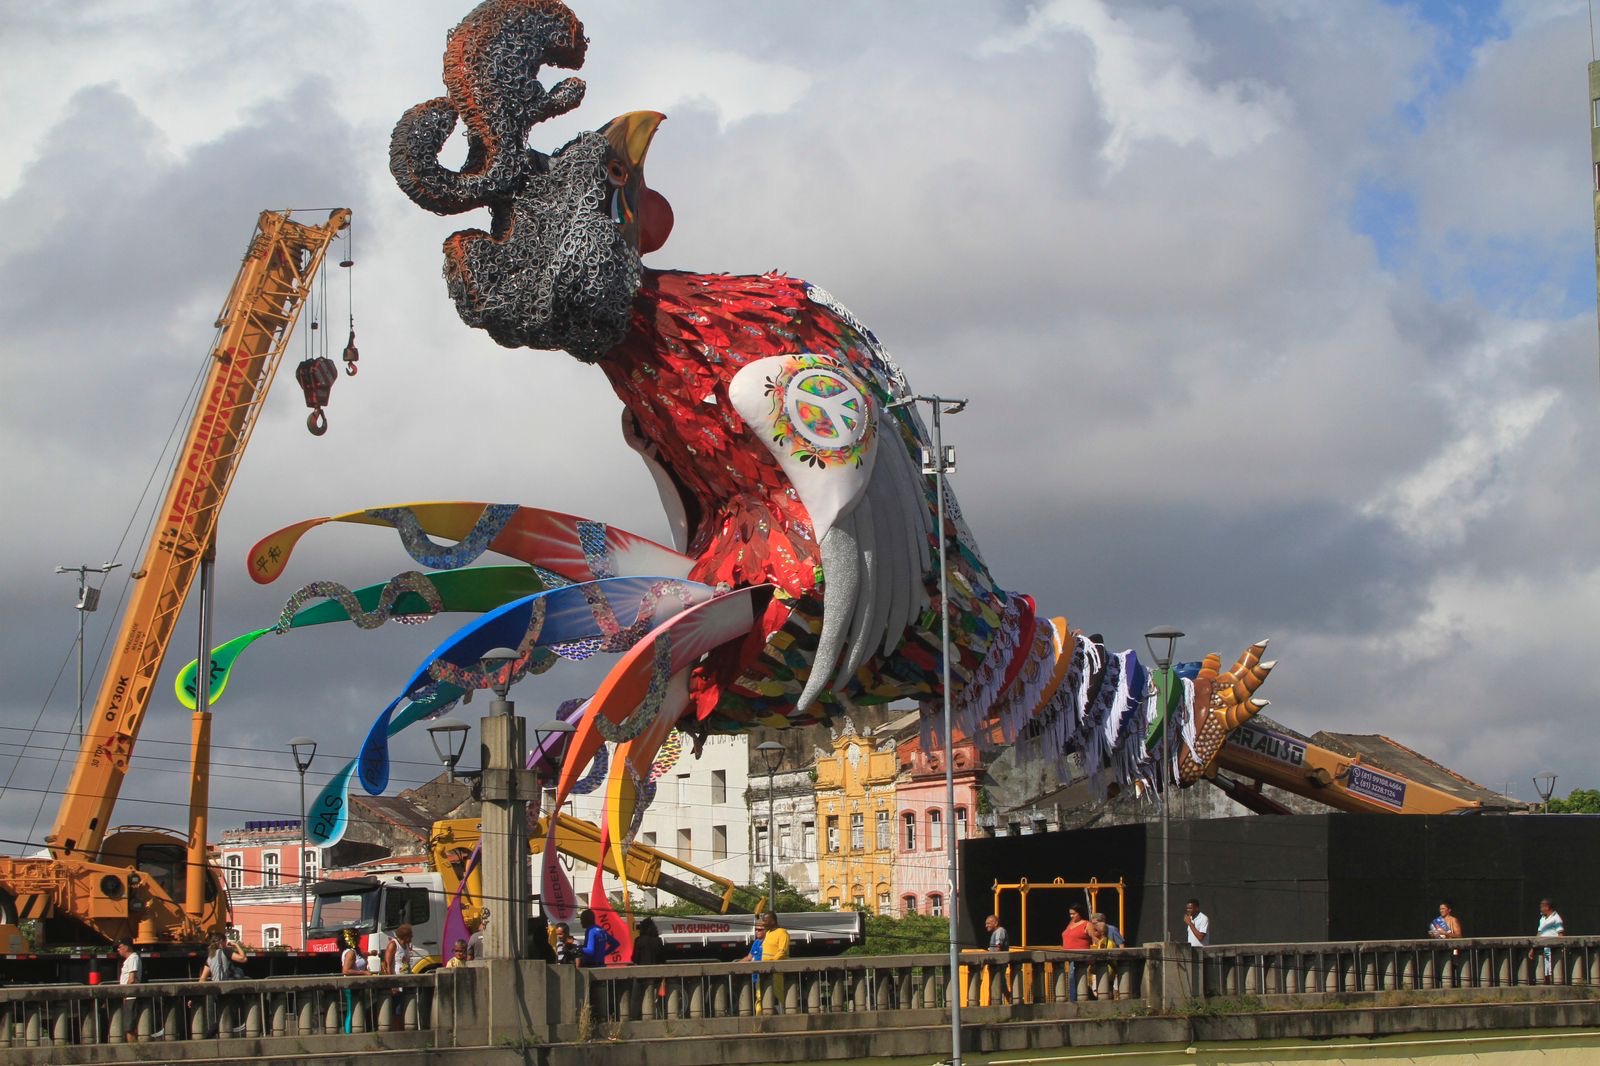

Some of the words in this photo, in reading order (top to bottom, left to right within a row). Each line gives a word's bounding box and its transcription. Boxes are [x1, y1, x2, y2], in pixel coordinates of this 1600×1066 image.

[187, 347, 250, 475] GUINCHO
[105, 675, 130, 722] QY30K
[91, 757, 100, 768] 30
[94, 743, 103, 759] TON
[365, 740, 385, 787] PAX
[1360, 779, 1371, 789] (81)
[1361, 771, 1372, 780] (81)
[313, 795, 343, 839] PAS
[548, 865, 568, 919] FRIEDEN
